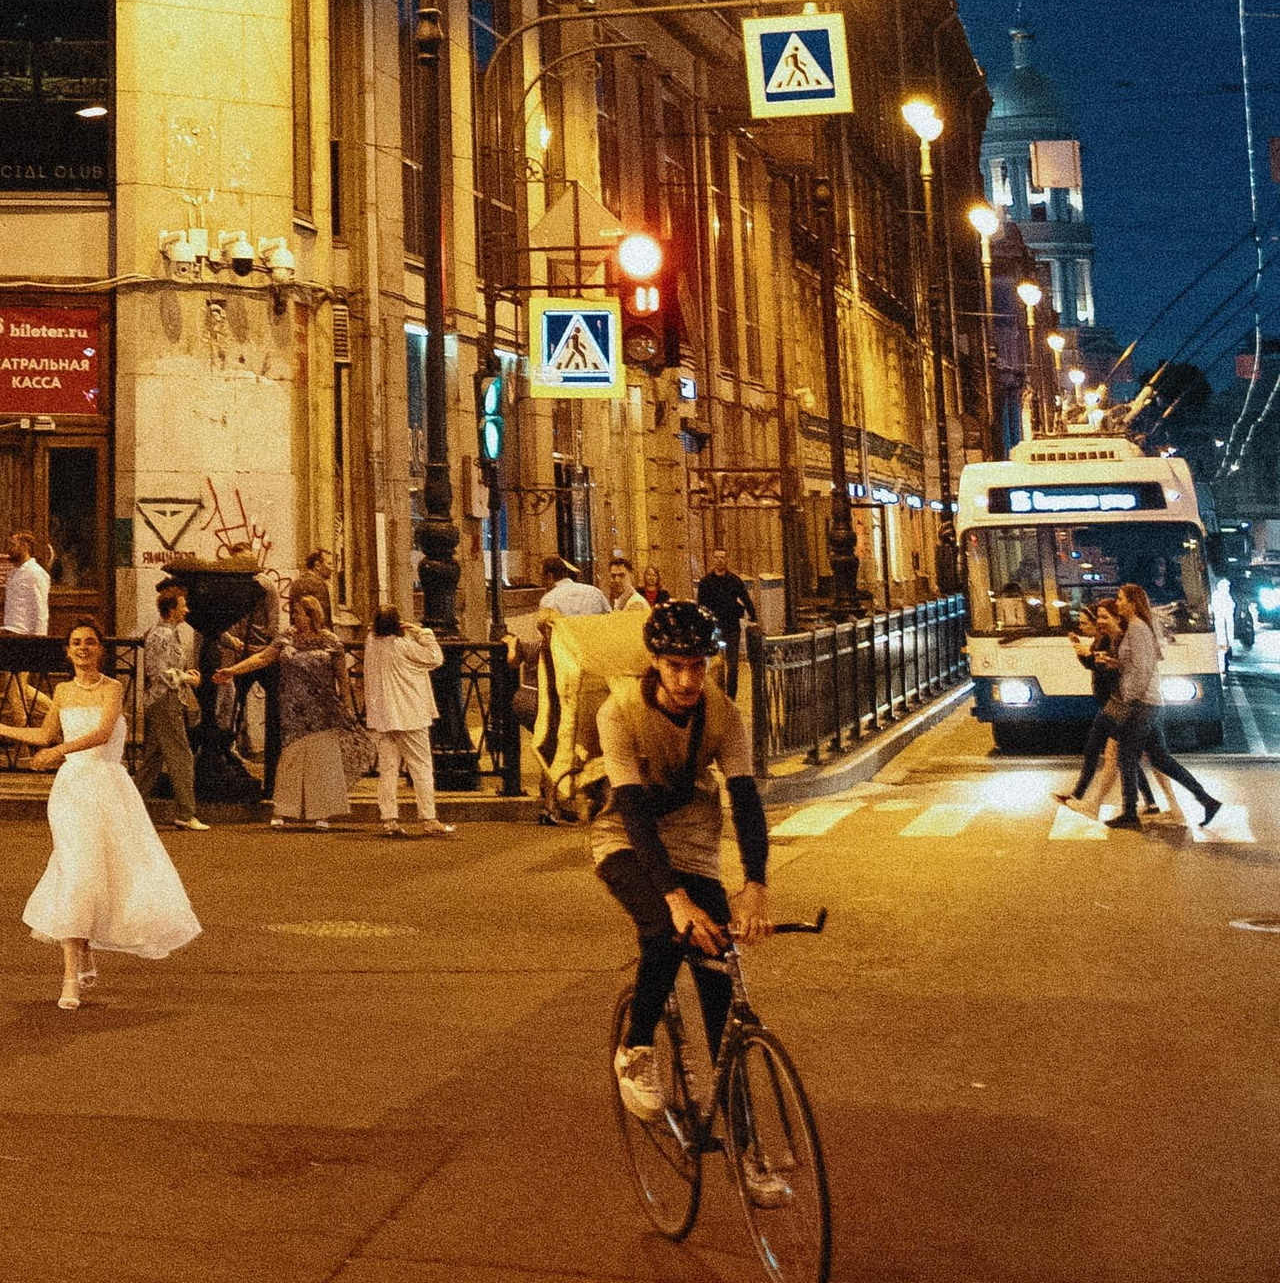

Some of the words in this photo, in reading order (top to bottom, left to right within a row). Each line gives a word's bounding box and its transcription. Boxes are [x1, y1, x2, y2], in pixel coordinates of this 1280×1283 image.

[54, 166, 103, 179] CLUB
[9, 324, 88, 338] bileter.ru
[11, 376, 62, 390] КАССА
